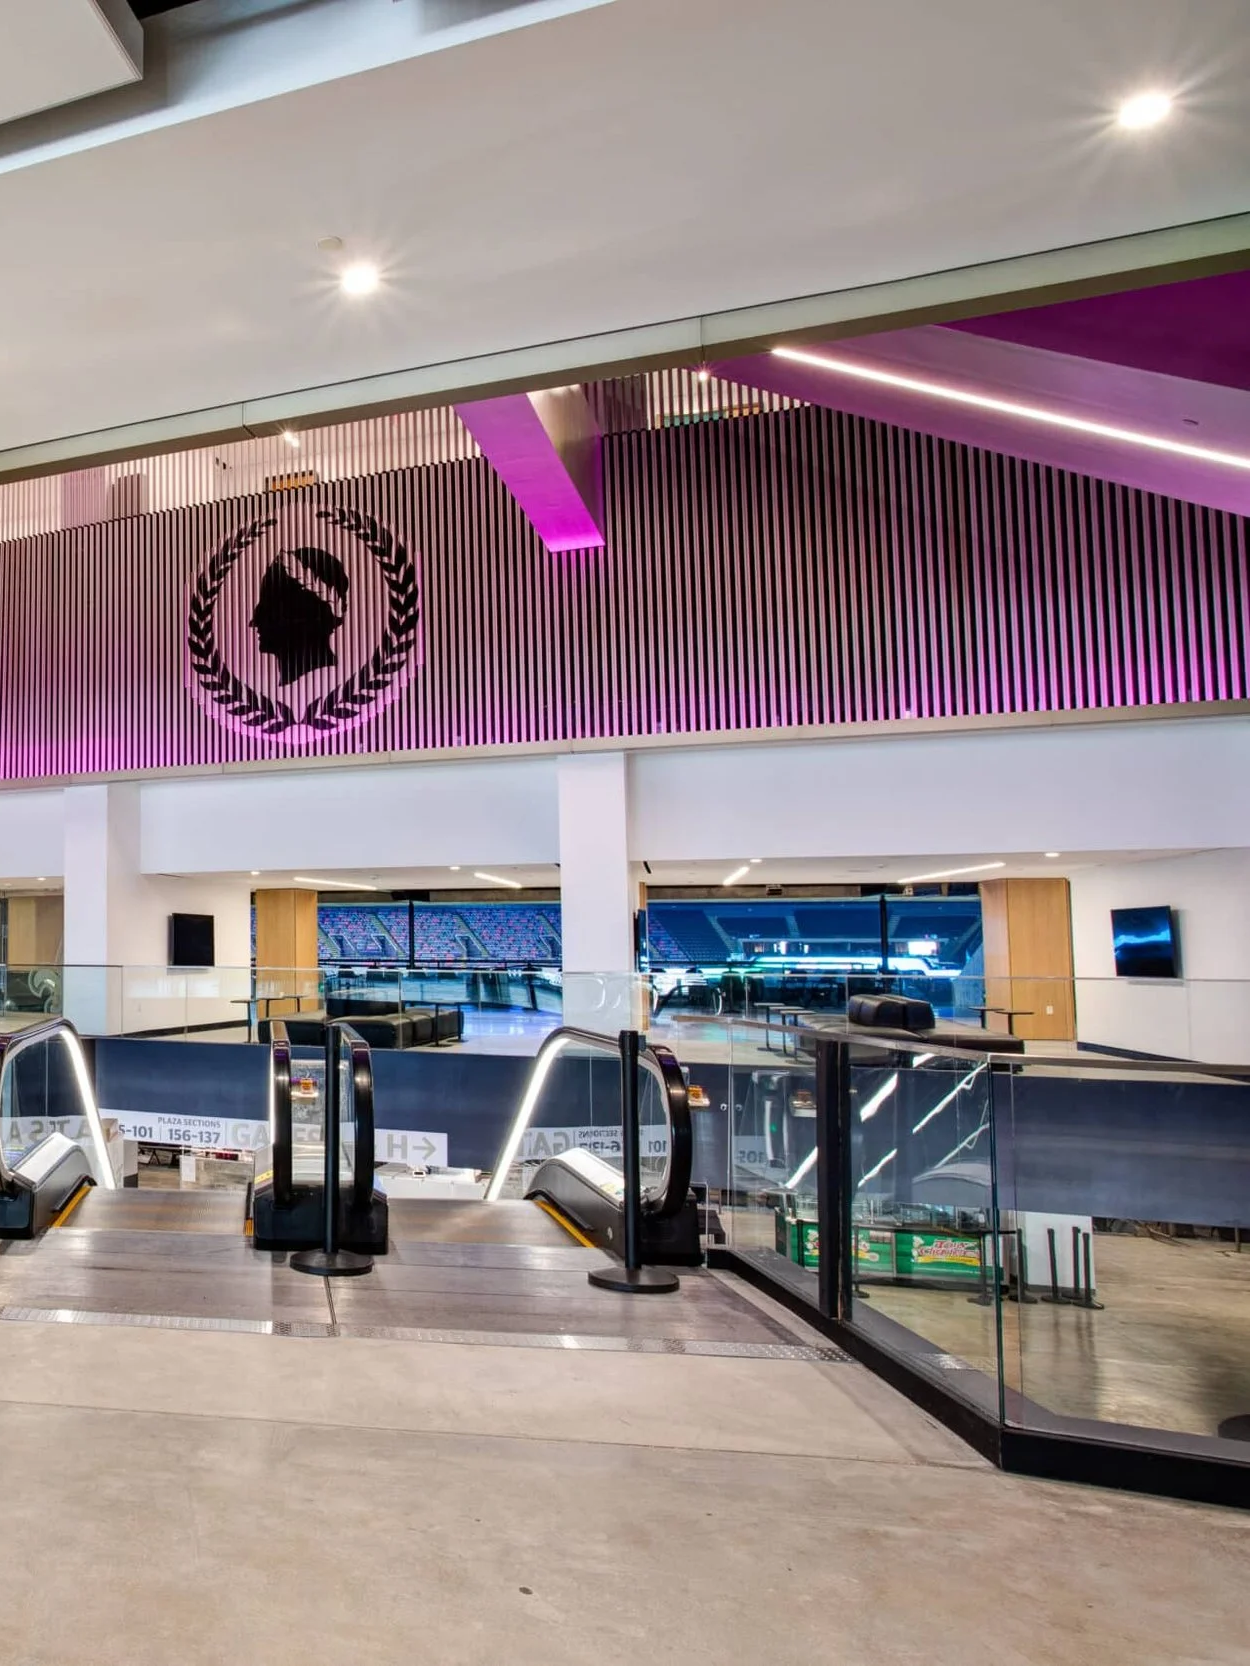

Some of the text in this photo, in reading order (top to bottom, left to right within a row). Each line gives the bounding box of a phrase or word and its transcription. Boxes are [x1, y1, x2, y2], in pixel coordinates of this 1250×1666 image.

[157, 1117, 222, 1129] PLAZA SECTIONS
[168, 1128, 221, 1145] 156-137
